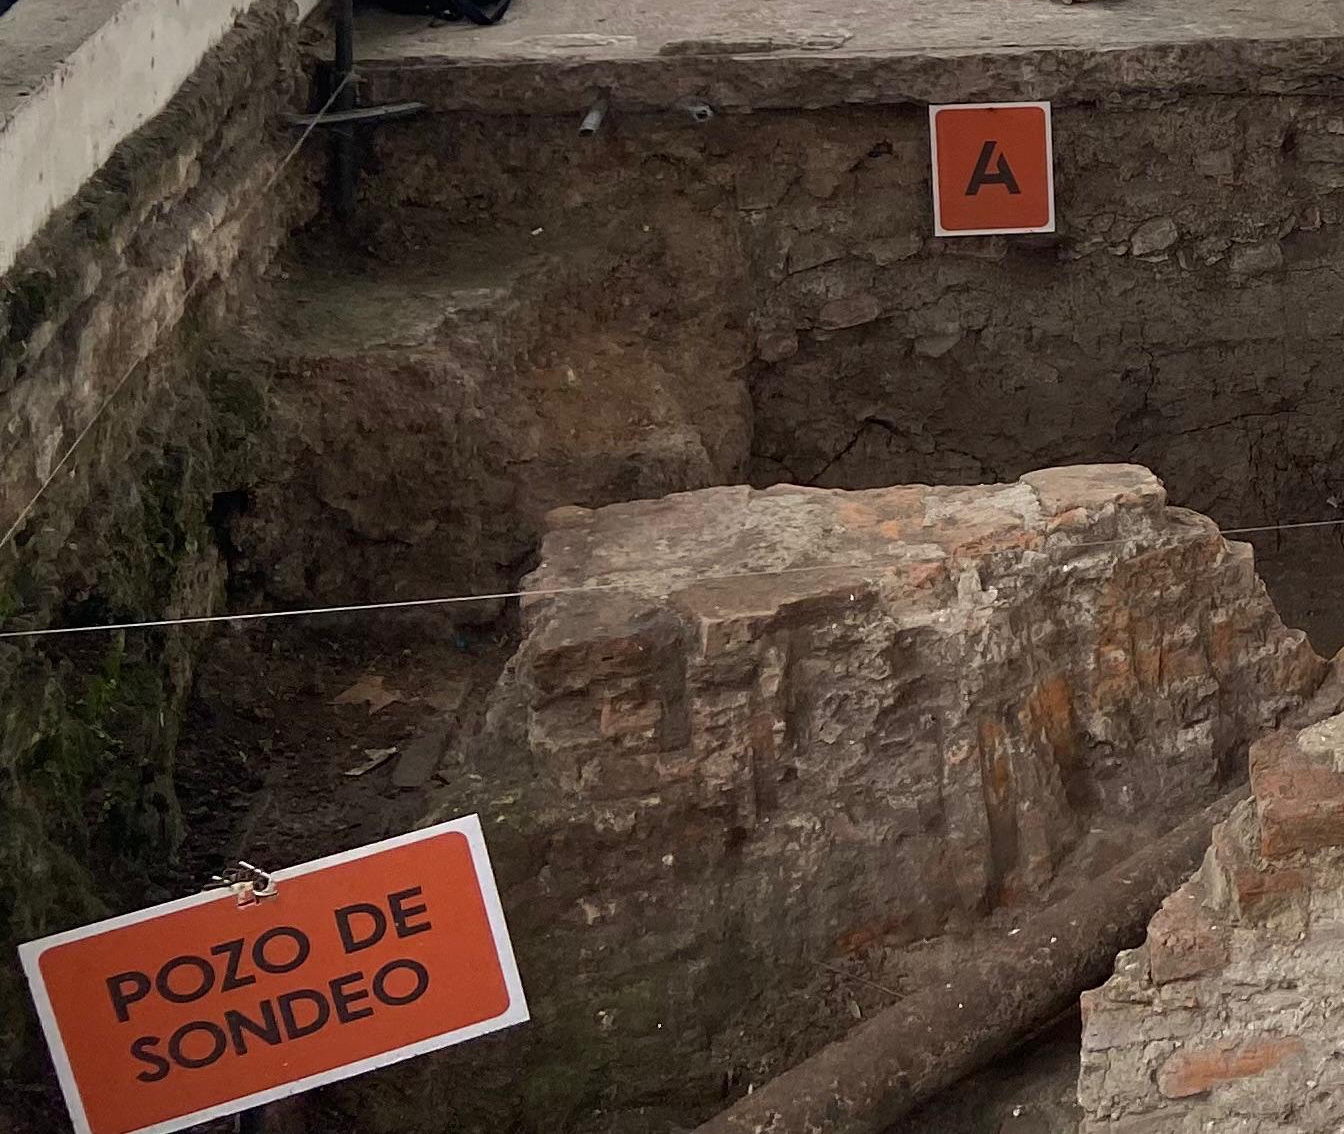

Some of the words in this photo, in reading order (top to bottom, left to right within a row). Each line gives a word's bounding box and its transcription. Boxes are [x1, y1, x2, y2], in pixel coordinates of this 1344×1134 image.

[964, 140, 1022, 196] A
[106, 926, 311, 1023] POZO
[334, 886, 432, 955] DE
[130, 957, 430, 1083] SONDEO
